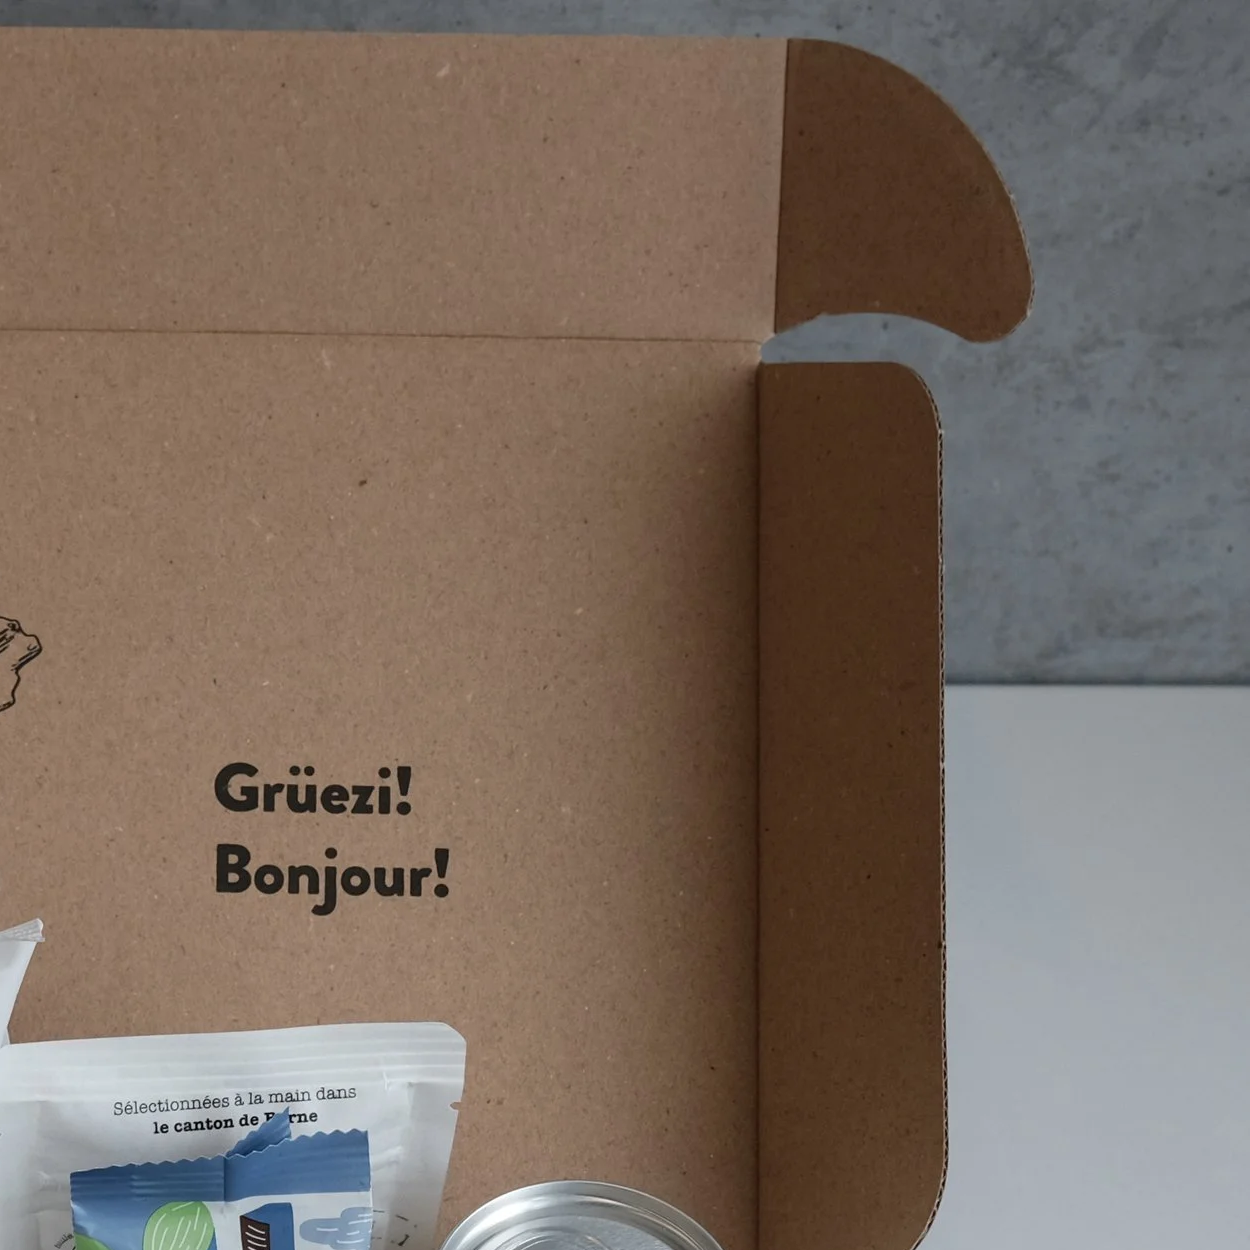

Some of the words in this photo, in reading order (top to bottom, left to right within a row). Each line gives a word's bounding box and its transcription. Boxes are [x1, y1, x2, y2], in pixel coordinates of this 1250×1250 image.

[214, 762, 411, 815] Grüezi!
[216, 844, 449, 916] Bonjour!
[113, 1095, 229, 1116] Sélectionnées
[234, 1094, 245, 1107] à
[248, 1092, 264, 1105] la
[268, 1089, 311, 1103] main
[316, 1086, 356, 1100] dans
[153, 1121, 169, 1134] le
[174, 1117, 234, 1133] canton
[239, 1114, 259, 1127] de
[264, 1111, 318, 1124] rne
